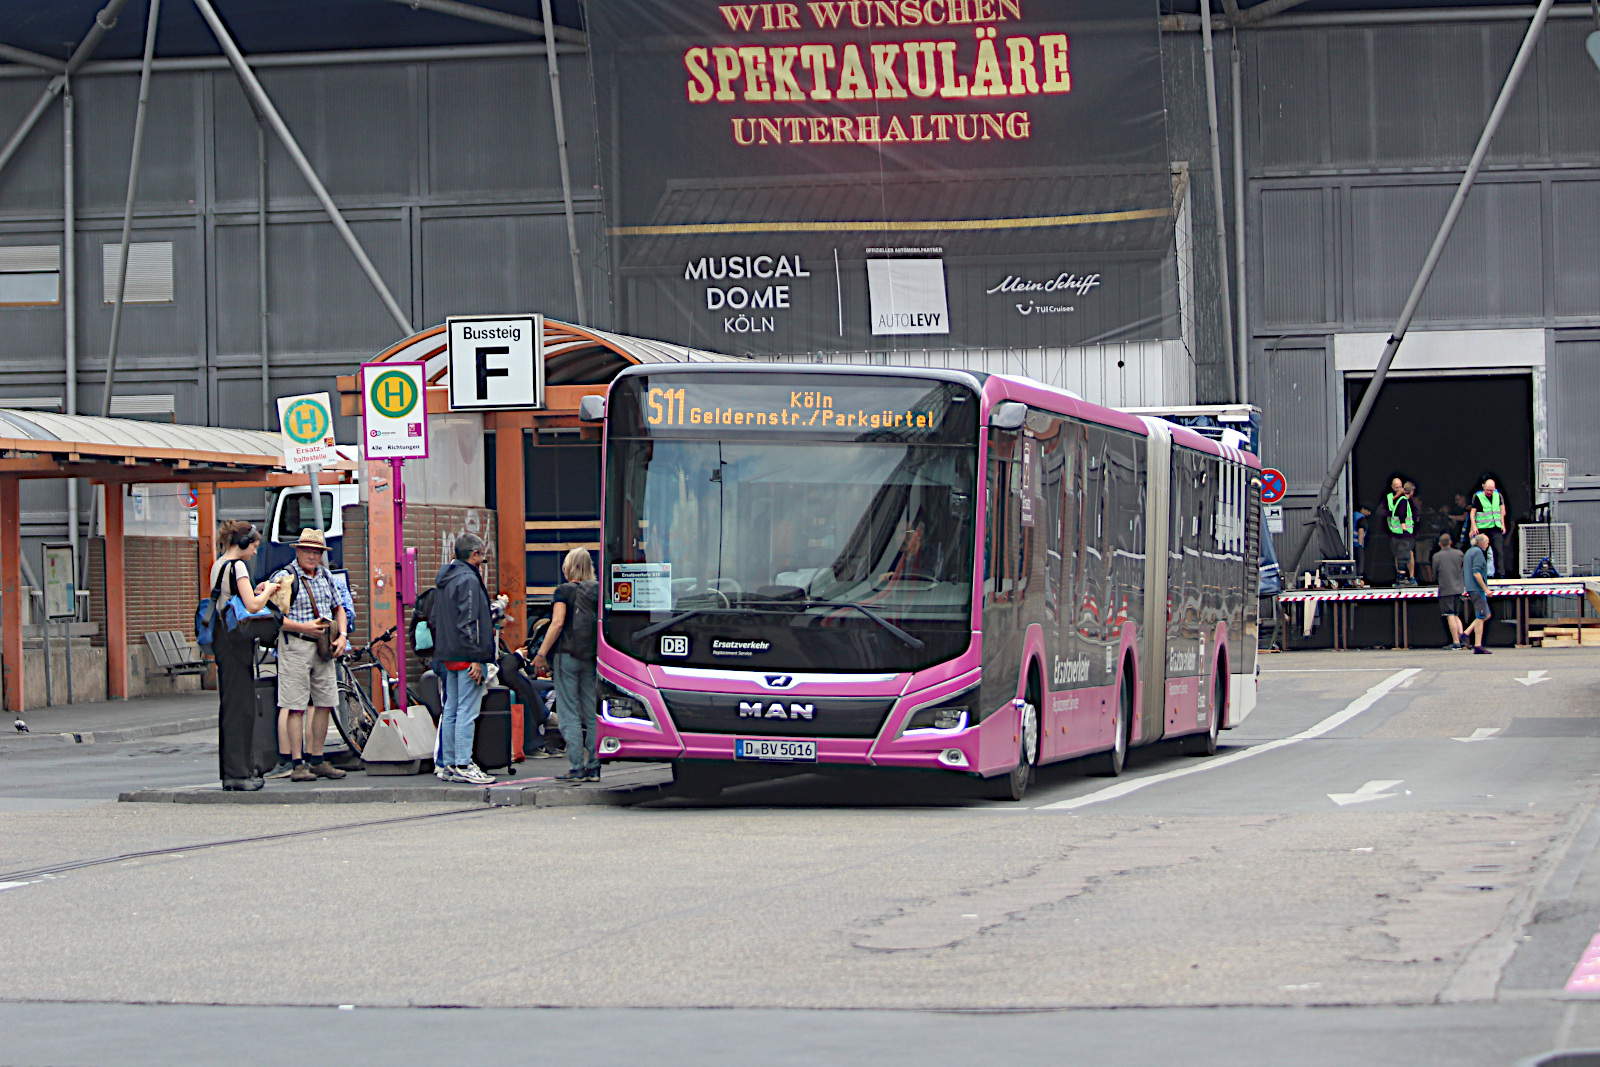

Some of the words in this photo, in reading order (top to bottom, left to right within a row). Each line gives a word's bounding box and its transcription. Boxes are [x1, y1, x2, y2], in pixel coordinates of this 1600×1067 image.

[719, 3, 801, 31] WIR
[685, 27, 1071, 102] SPEKTAKULÄRE
[731, 112, 1030, 144] UNTERHALTUNG
[685, 255, 810, 280] MUSICAL
[986, 276, 1043, 294] Mein
[1044, 272, 1100, 296] Schiff
[706, 285, 790, 310] DOME
[724, 313, 774, 333] KÖLN
[879, 313, 941, 328] AUTOLEVY
[463, 325, 521, 342] Bussteig
[475, 346, 509, 400] F
[385, 381, 404, 407] H
[790, 391, 833, 408] Köln
[648, 388, 685, 425] S11
[295, 409, 317, 434] H
[690, 408, 934, 428] Geldernstr./Parkgürtel
[294, 454, 327, 463] haltestelle
[296, 446, 323, 455] Ersatz-
[664, 638, 685, 653] DB
[713, 640, 770, 650] Ersatzverkehr
[1053, 653, 1090, 684] Ersatzverkehr
[739, 701, 814, 719] MAN
[745, 742, 753, 755] D
[761, 743, 779, 755] BV
[781, 743, 813, 757] 5016
